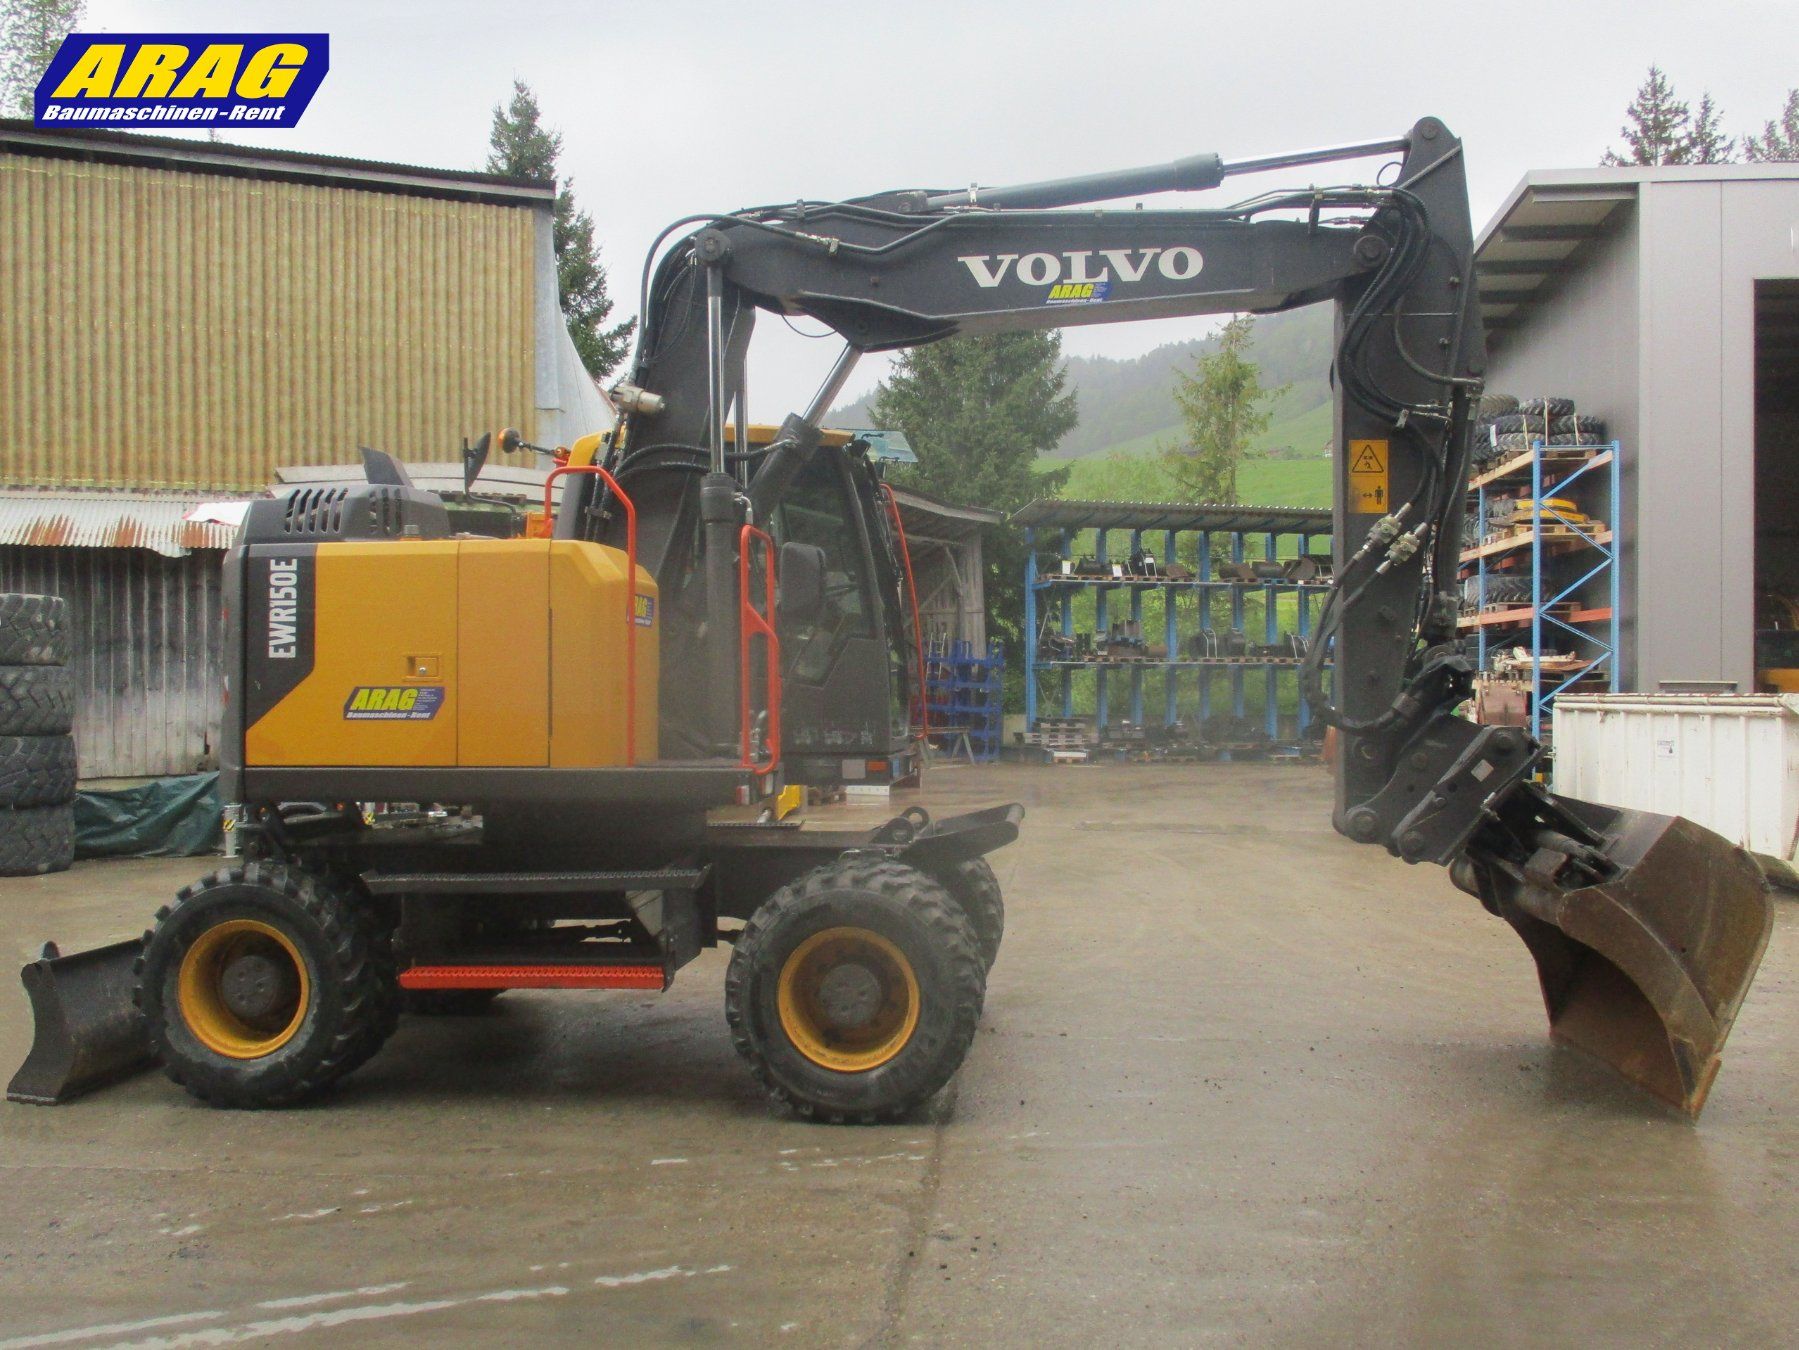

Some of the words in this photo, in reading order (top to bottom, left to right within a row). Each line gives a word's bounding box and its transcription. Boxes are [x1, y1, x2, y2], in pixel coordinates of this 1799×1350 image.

[957, 247, 1204, 288] VOLVO
[1048, 283, 1095, 299] ARAG
[268, 558, 298, 659] EWR150E
[349, 688, 419, 711] ARAG
